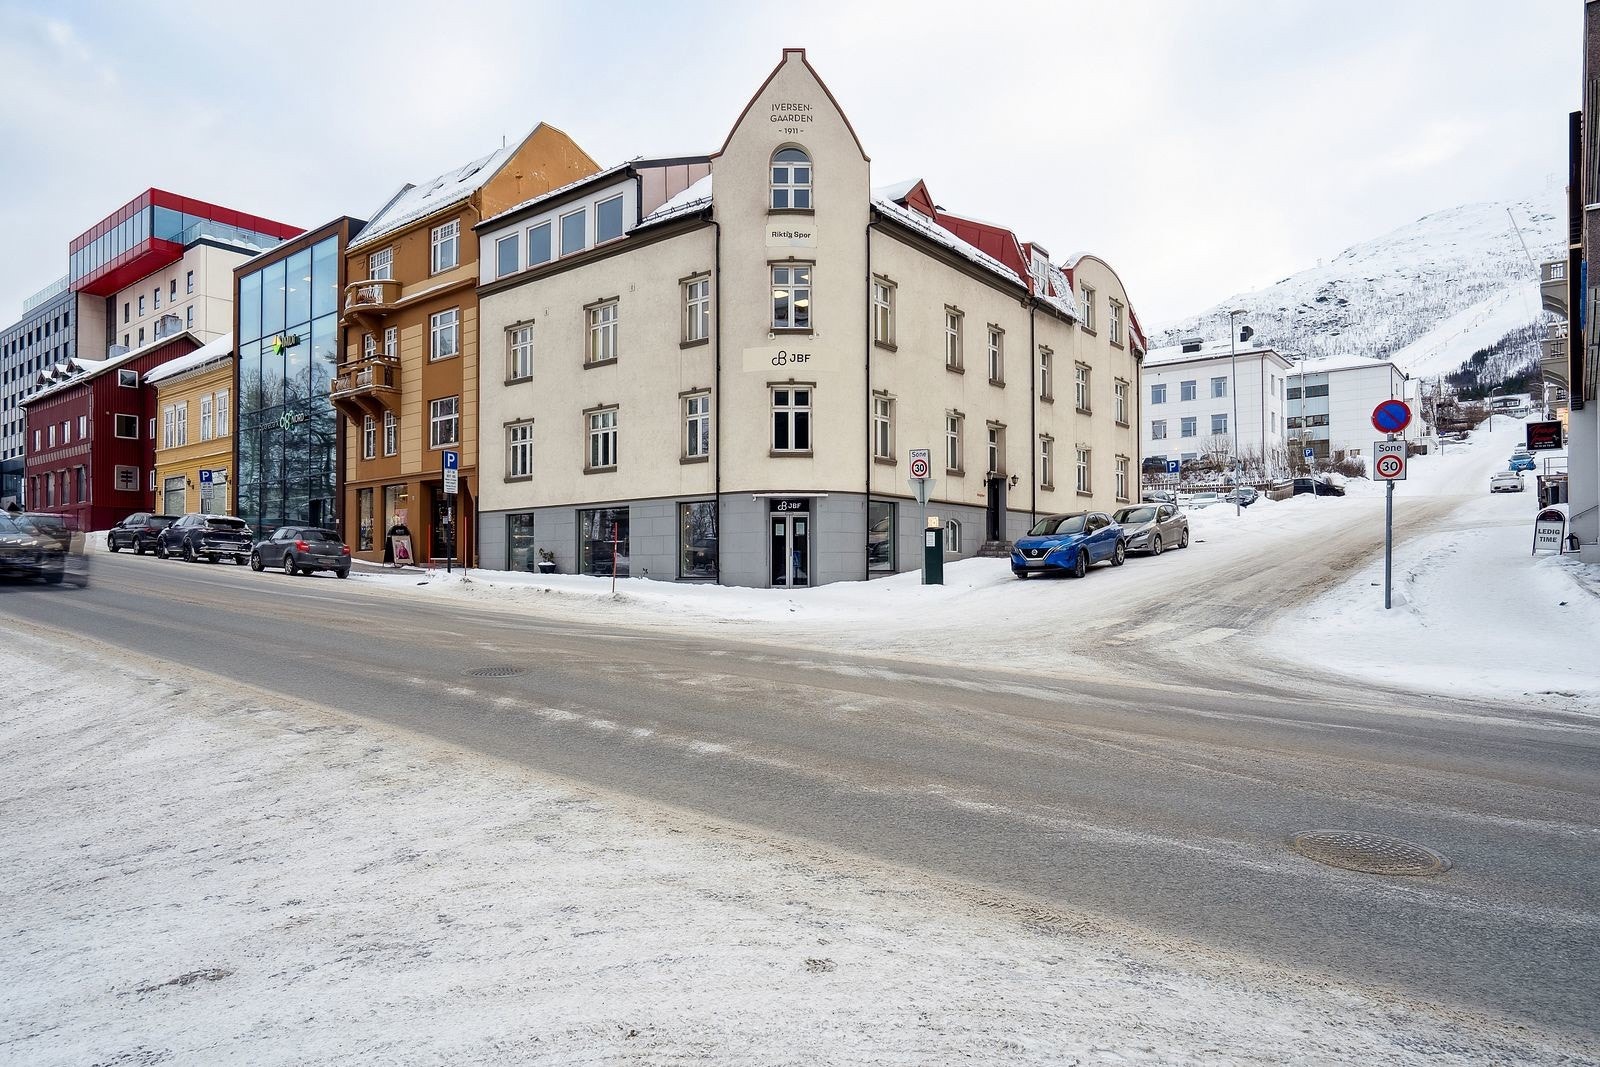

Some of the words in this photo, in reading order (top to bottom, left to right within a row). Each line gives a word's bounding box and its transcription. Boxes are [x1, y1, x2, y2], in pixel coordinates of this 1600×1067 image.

[771, 103, 813, 112] IVERSEN-
[770, 114, 813, 123] GAARDEN
[771, 230, 793, 240] Riktig
[793, 231, 811, 239] Spor
[789, 353, 812, 363] JBF
[1305, 449, 1312, 457] P
[1378, 444, 1402, 453] Sone
[447, 452, 456, 468] P
[914, 463, 925, 473] 30
[1169, 461, 1177, 472] P
[1382, 461, 1399, 472] 30
[202, 471, 210, 481] P
